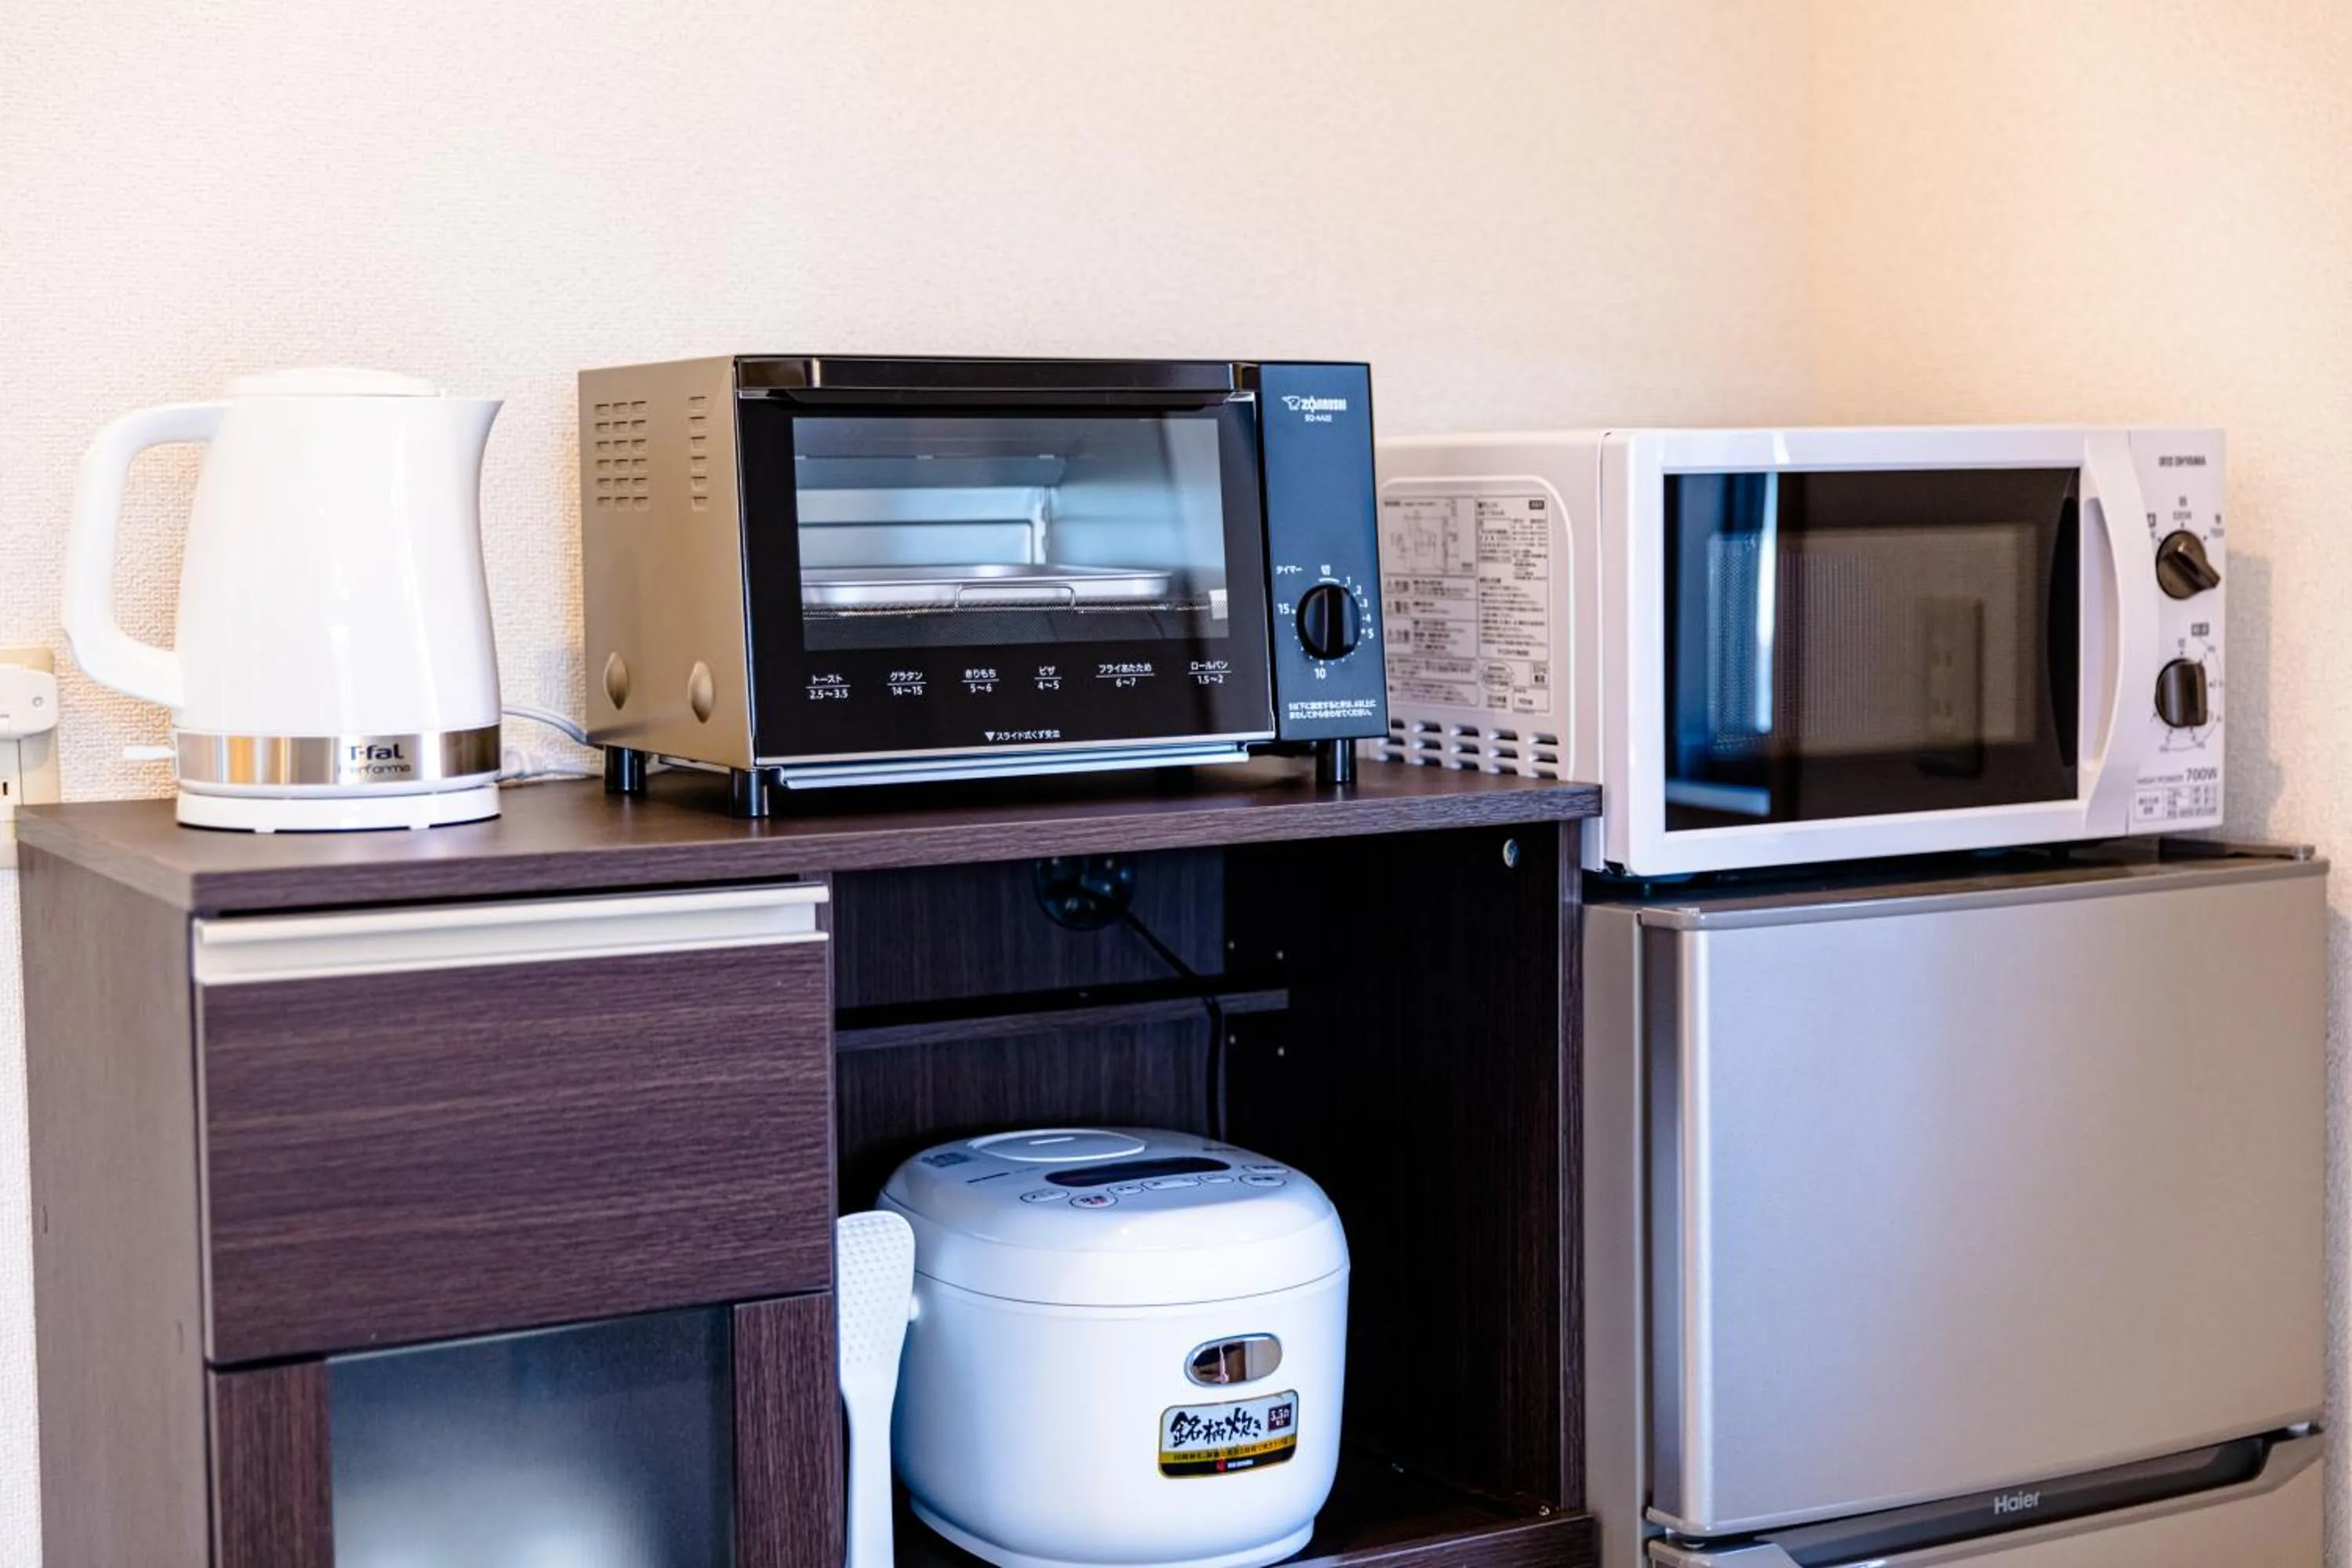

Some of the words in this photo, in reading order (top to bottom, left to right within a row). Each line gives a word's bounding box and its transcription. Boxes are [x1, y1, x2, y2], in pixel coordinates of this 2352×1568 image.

[1276, 565, 1302, 574] タイマー
[1356, 585, 1362, 595] 2
[1363, 598, 1369, 608] 3
[1277, 603, 1290, 614] 15
[1365, 614, 1371, 622] 4
[1367, 628, 1374, 639] 5
[1098, 663, 1152, 673] フライあたため
[1190, 661, 1229, 670] ロールパン
[890, 671, 924, 681] グラタン
[1038, 666, 1056, 676] ピザ
[1314, 668, 1327, 679] 10
[812, 674, 843, 684] トースト
[346, 743, 405, 760] T-fal
[2186, 767, 2217, 782] 700W
[1170, 1407, 1261, 1447] 銘柄炊き
[1994, 1490, 2041, 1515] Haier
